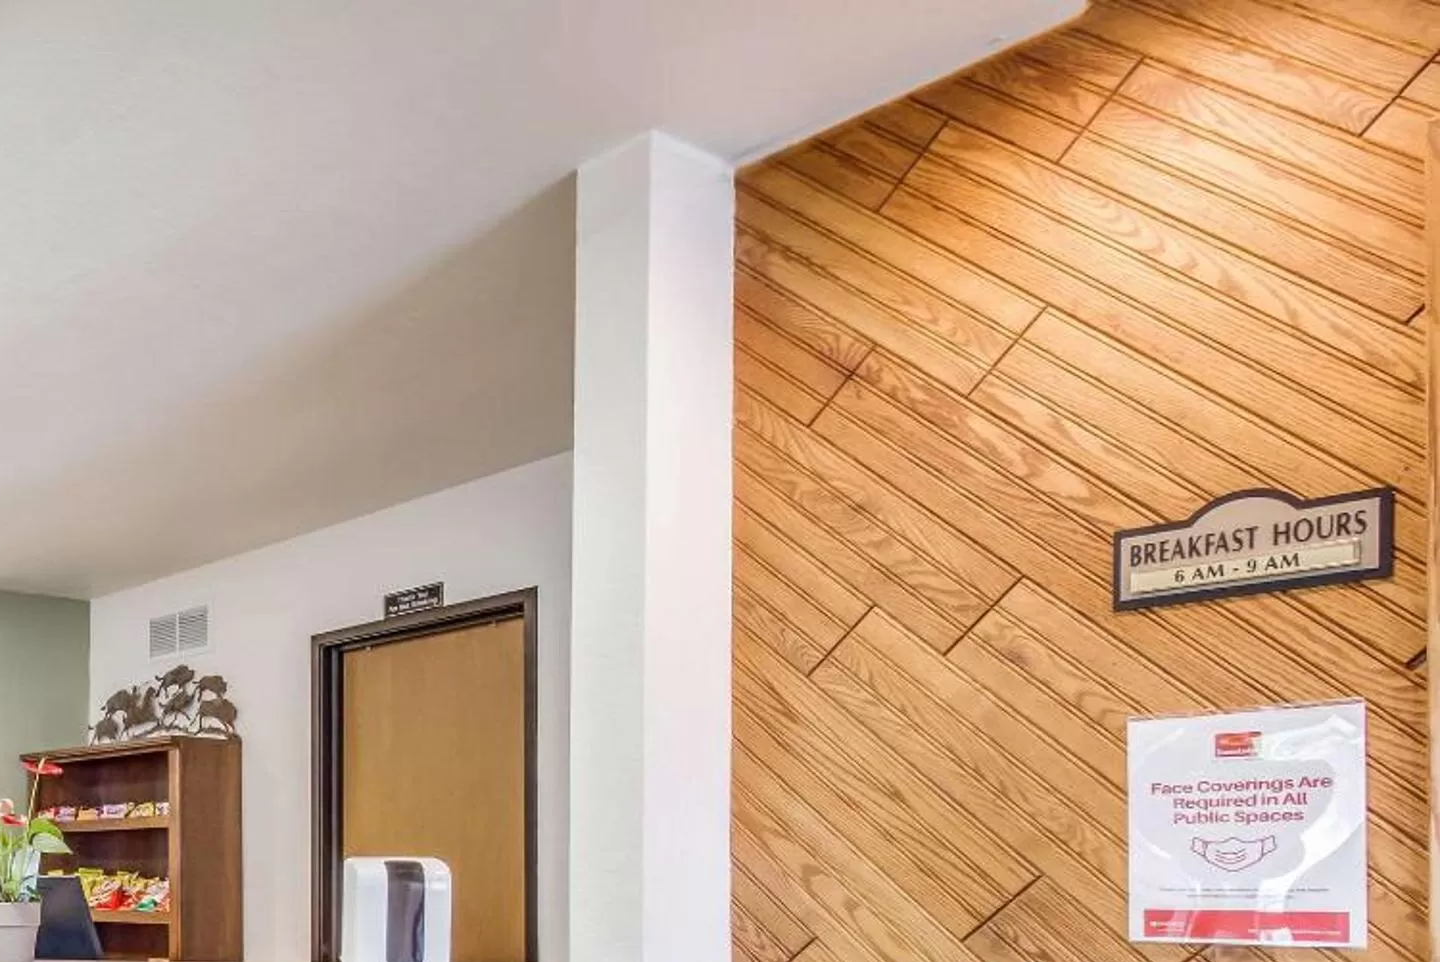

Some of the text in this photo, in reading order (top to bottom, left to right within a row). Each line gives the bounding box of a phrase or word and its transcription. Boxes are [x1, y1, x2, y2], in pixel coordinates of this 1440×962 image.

[1130, 510, 1367, 567] BREAKFAST HOURS
[1174, 569, 1185, 583] 6
[1192, 564, 1225, 581] AM
[1247, 560, 1257, 573] 9
[1264, 553, 1300, 571] AM
[1151, 776, 1333, 795] Face Coverings Are
[1173, 792, 1308, 810] Required in All
[1173, 811, 1305, 826] Public Spaces
